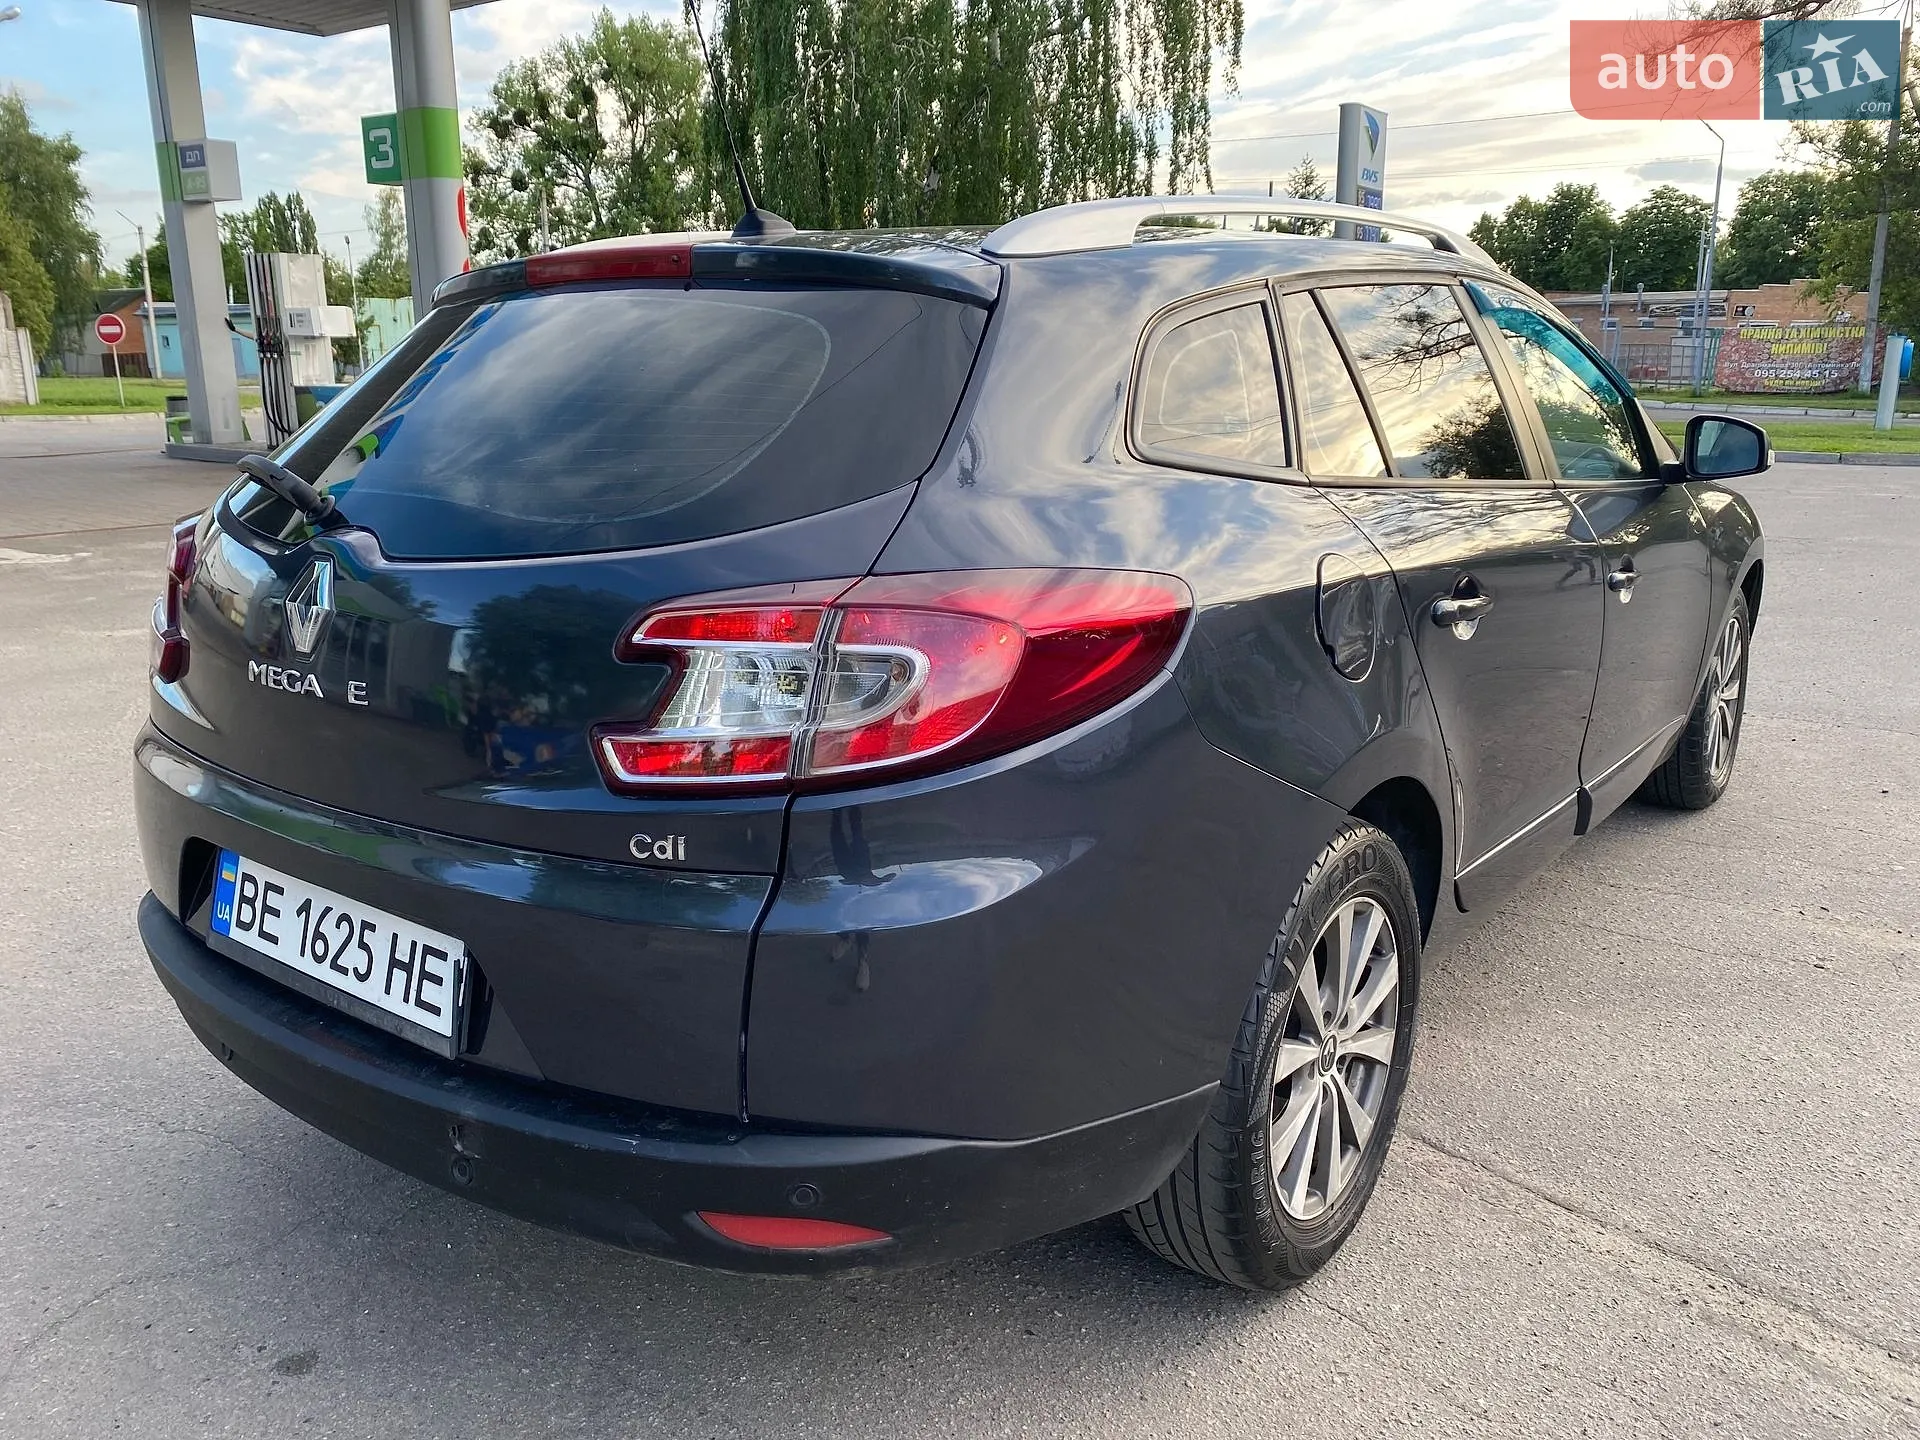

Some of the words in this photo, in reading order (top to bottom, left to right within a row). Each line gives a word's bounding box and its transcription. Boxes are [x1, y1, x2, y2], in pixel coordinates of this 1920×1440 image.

[368, 127, 395, 169] 3
[1361, 167, 1379, 183] BVS
[1740, 327, 1782, 339] ПРАННЯ
[1754, 369, 1776, 378] 095
[1779, 369, 1801, 378] 254
[1804, 369, 1820, 378] 45
[1824, 369, 1839, 378] 15
[217, 900, 231, 922] UA
[235, 871, 285, 946] BE
[295, 896, 377, 984] 1625
[383, 931, 449, 1018] HE
